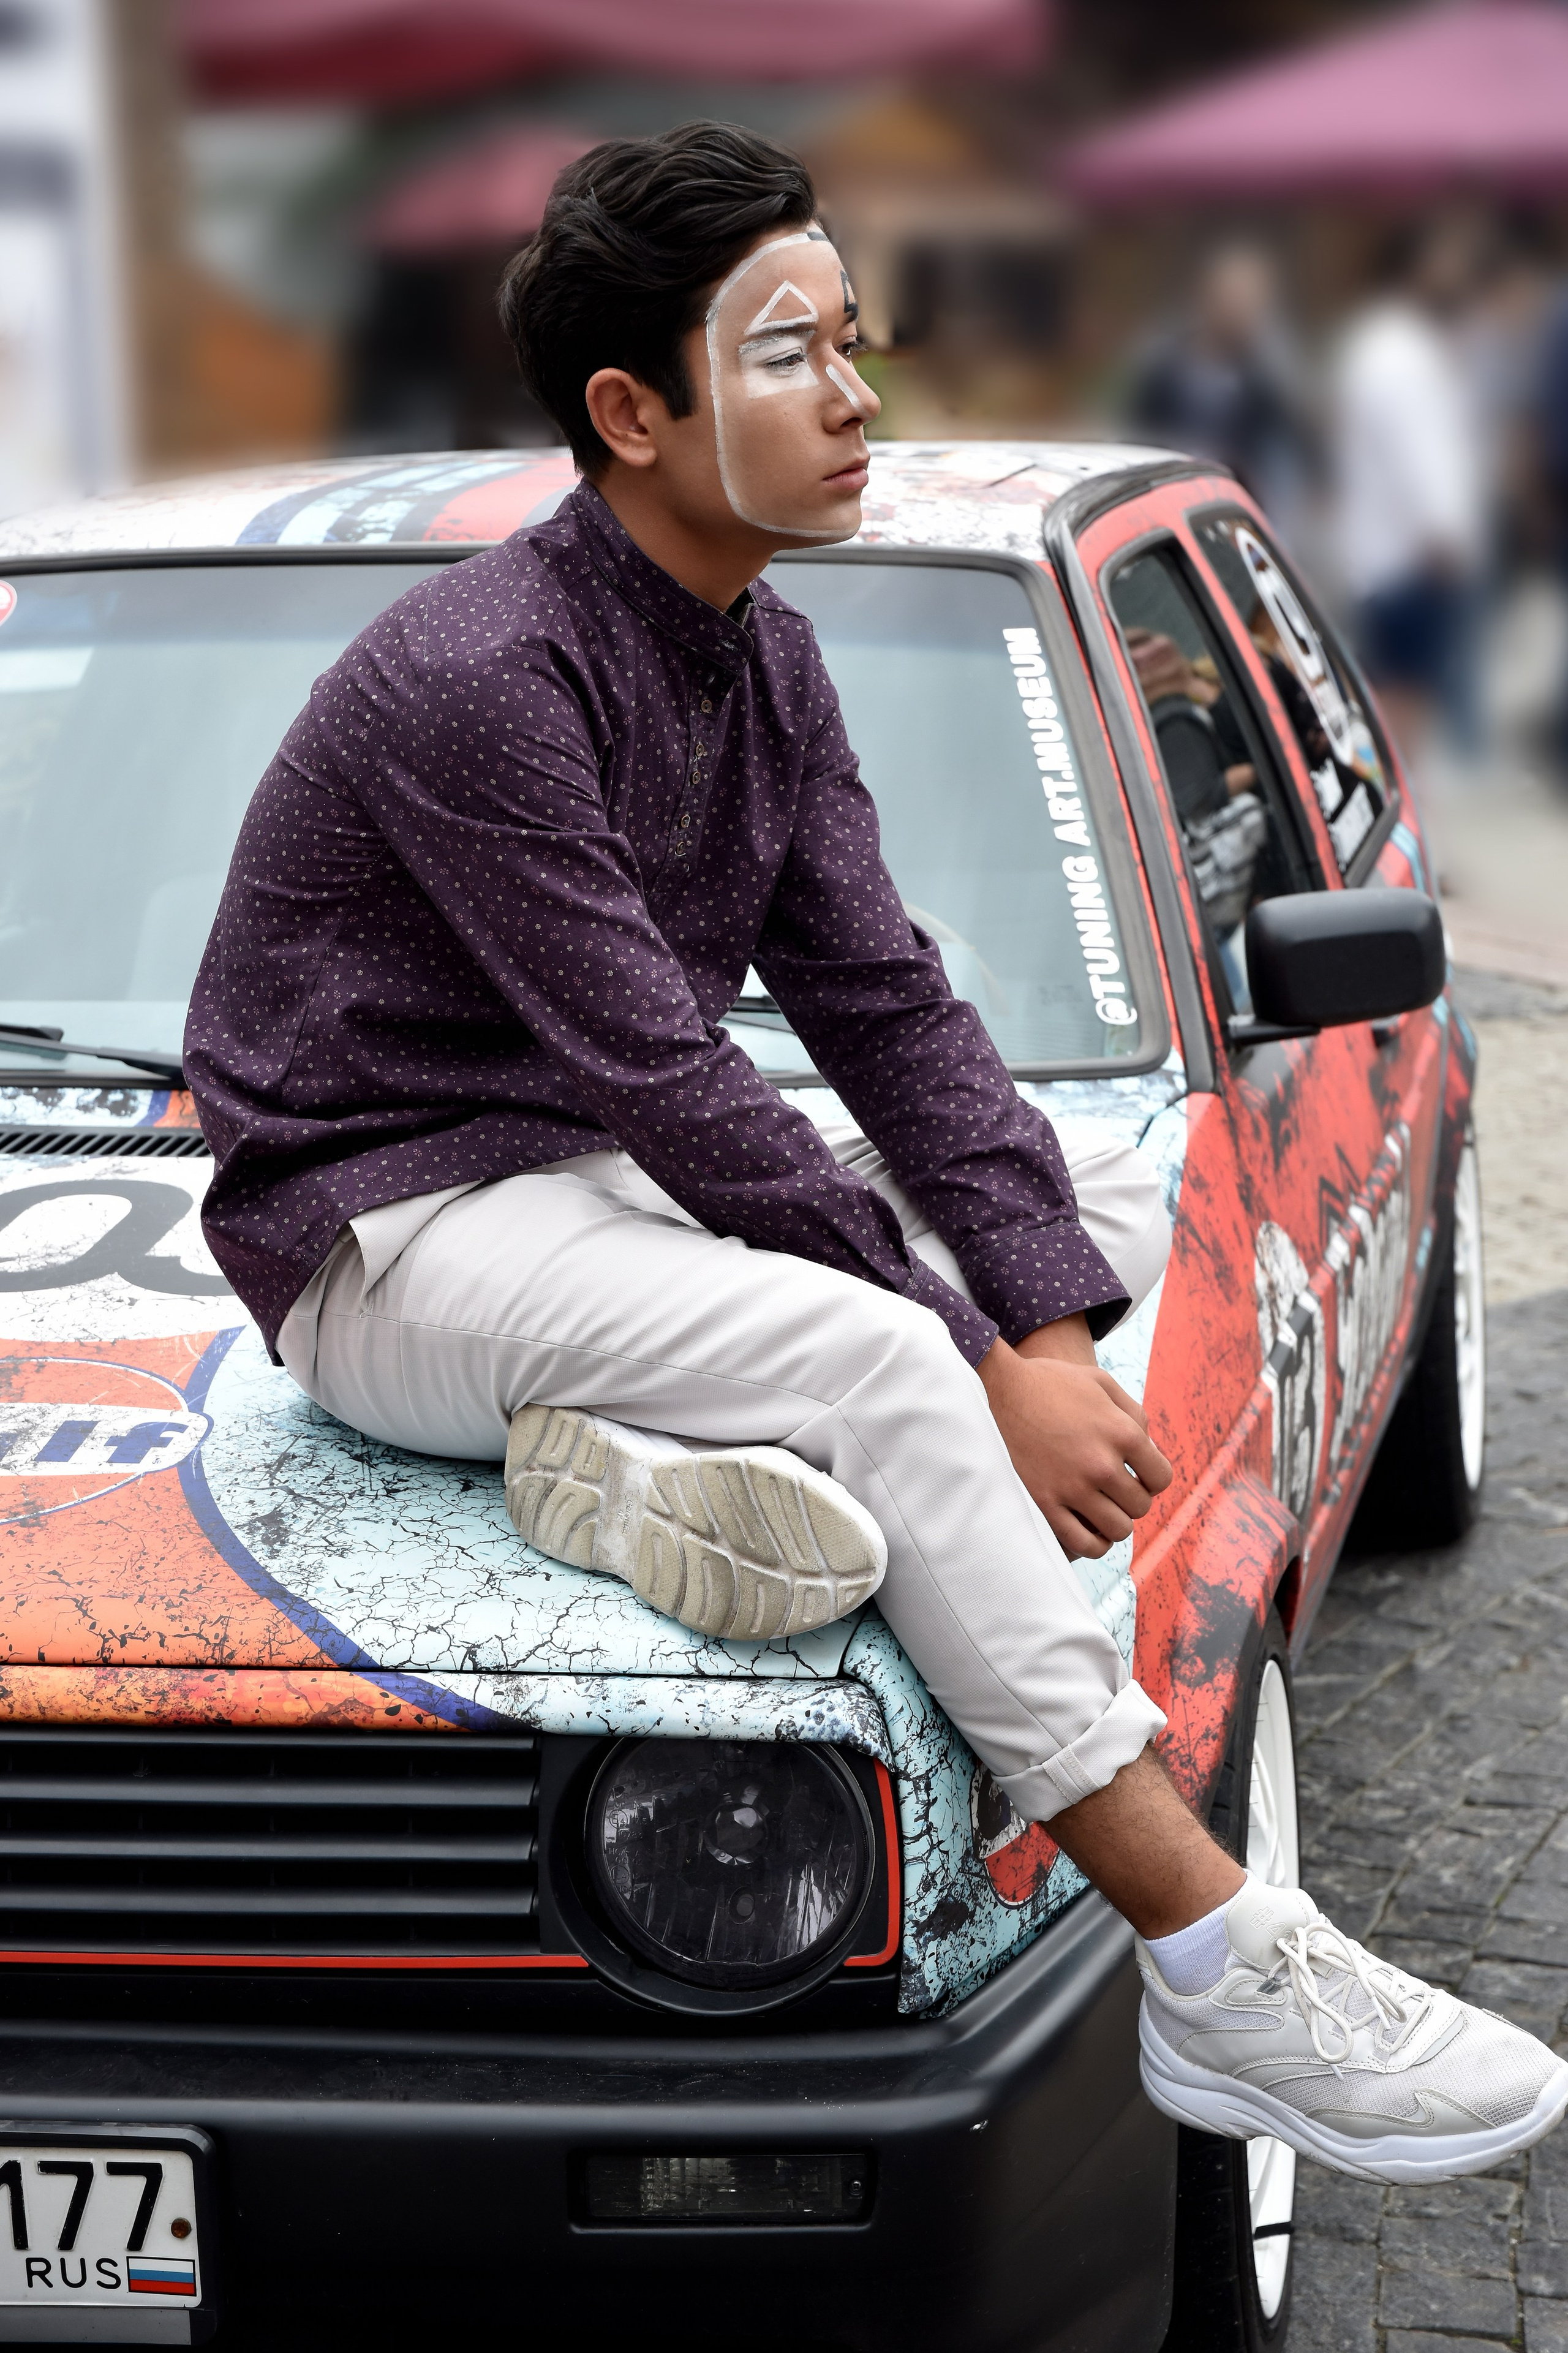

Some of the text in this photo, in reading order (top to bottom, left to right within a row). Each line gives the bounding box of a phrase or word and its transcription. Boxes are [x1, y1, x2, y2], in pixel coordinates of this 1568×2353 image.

[1002, 627, 1137, 1025] @TUNING ART.MUSEUM
[0, 1420, 189, 1464] lf
[0, 2159, 163, 2251] 177
[25, 2257, 121, 2289] RUS
